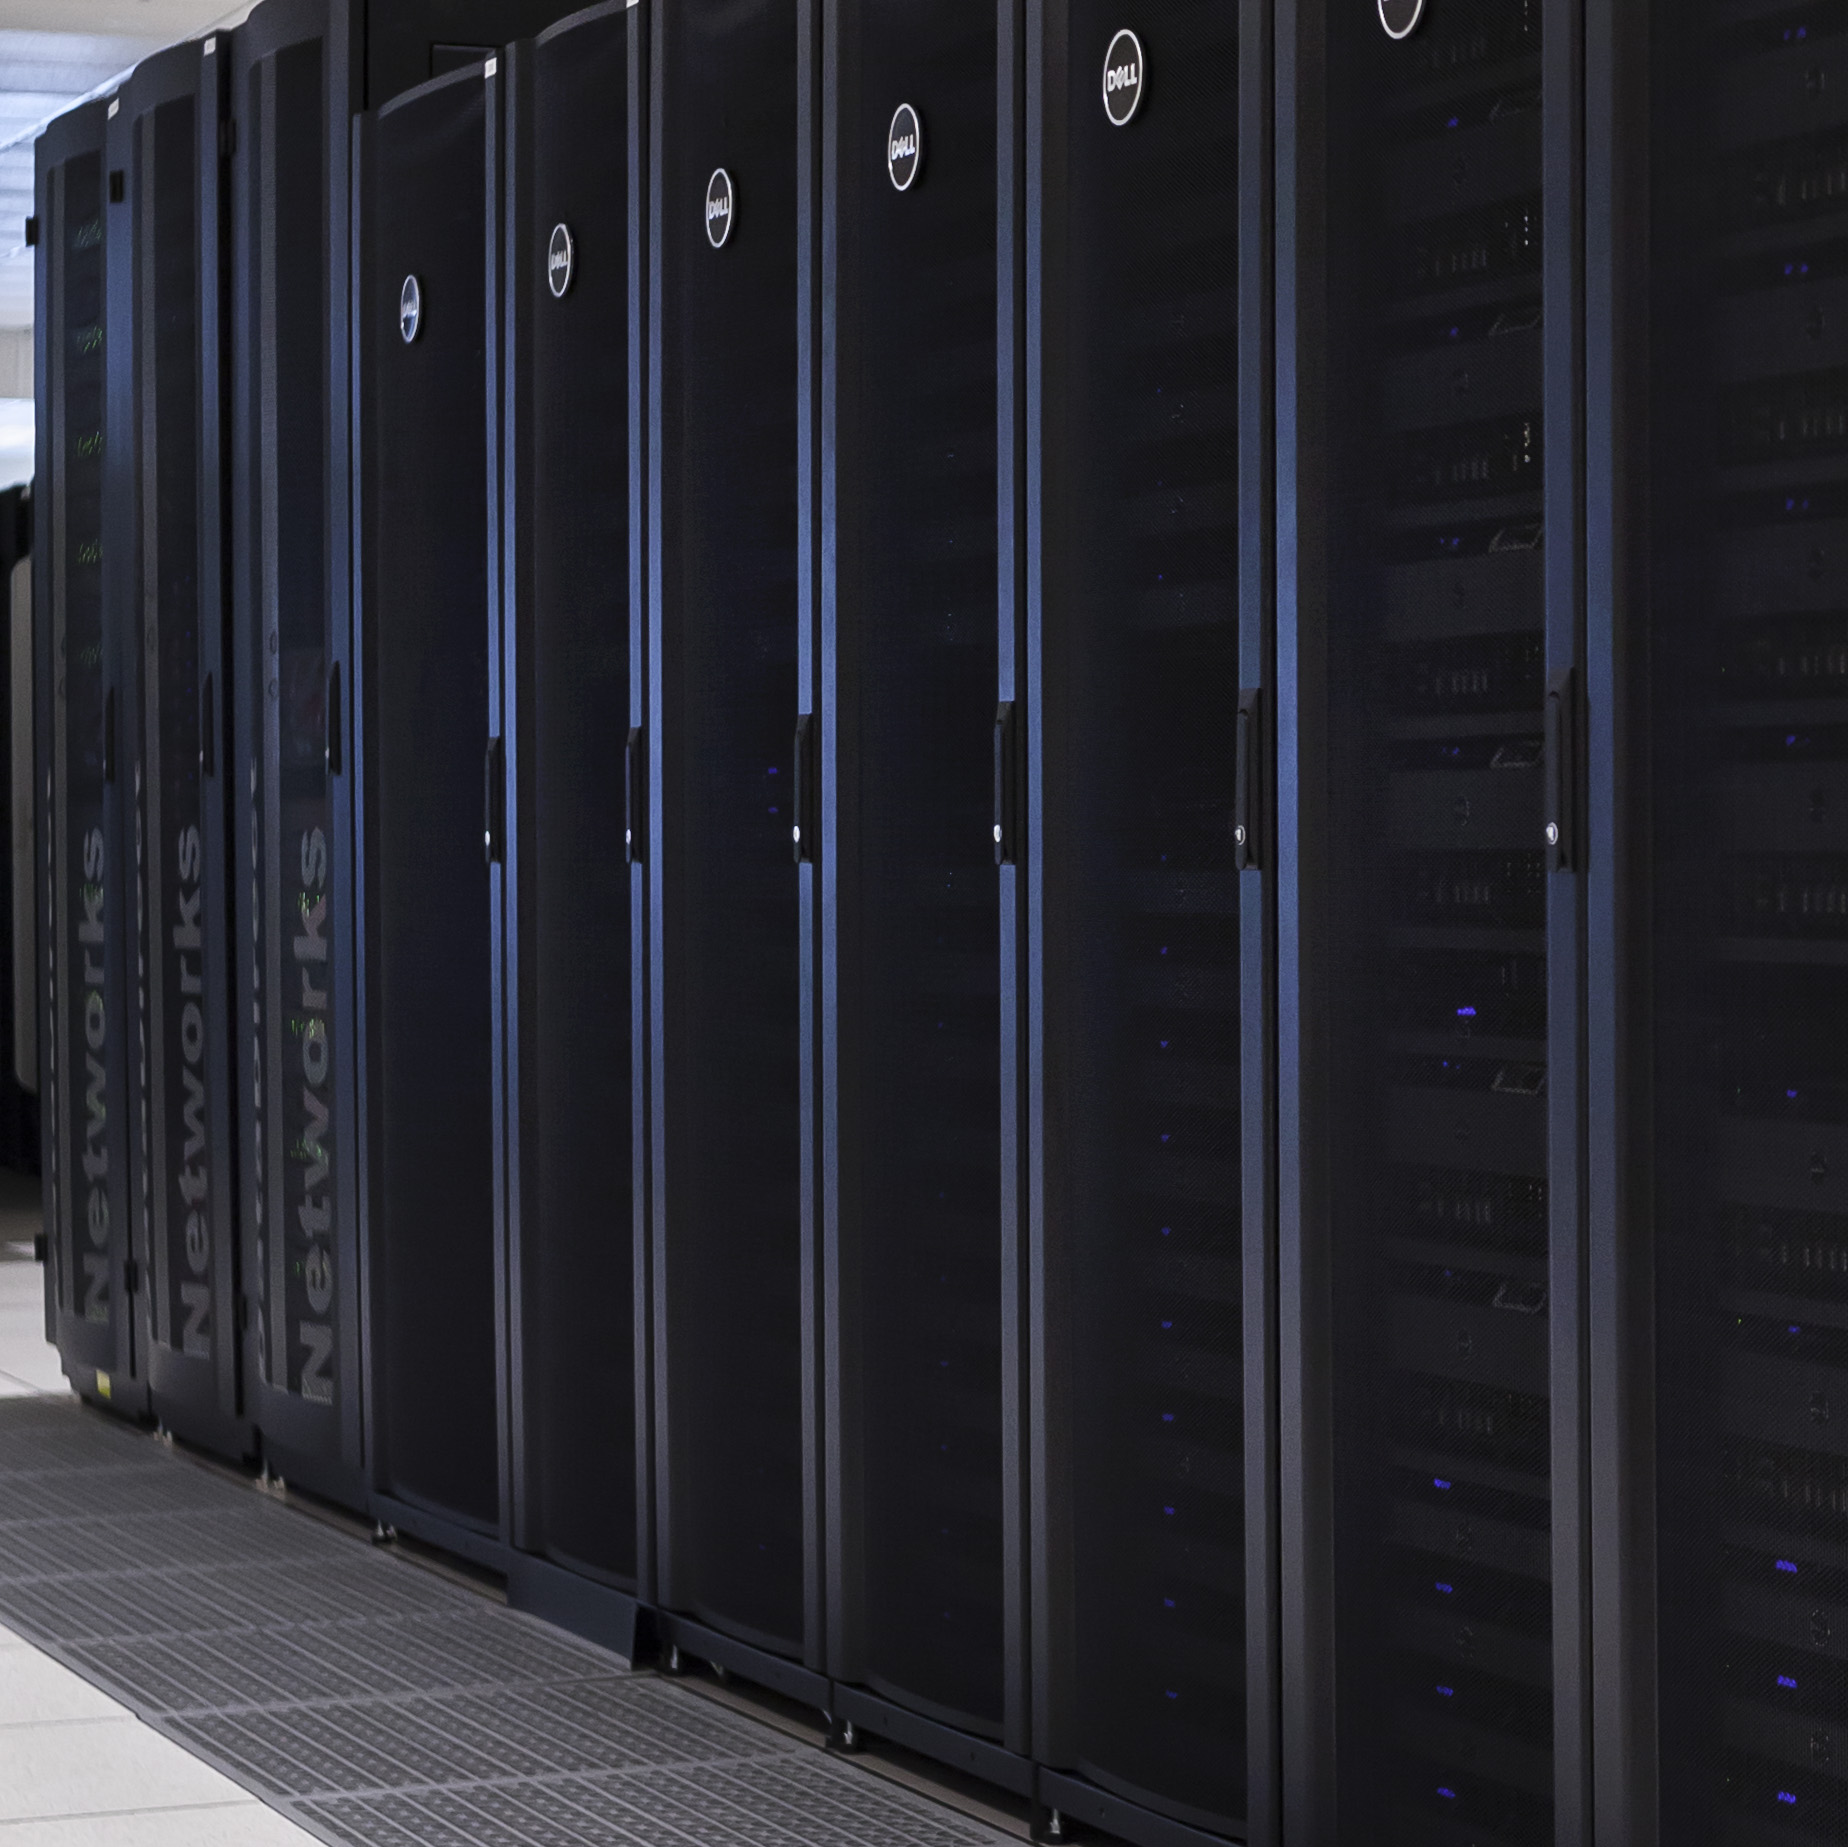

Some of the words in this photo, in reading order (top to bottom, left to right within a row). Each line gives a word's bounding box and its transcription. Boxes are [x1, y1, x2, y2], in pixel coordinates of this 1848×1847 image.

[707, 196, 729, 220] DELL
[891, 134, 916, 161] DELL
[1106, 63, 1138, 93] DELL
[78, 824, 110, 1324] Networks
[173, 824, 211, 1361] Networks
[294, 825, 334, 1406] Networks
